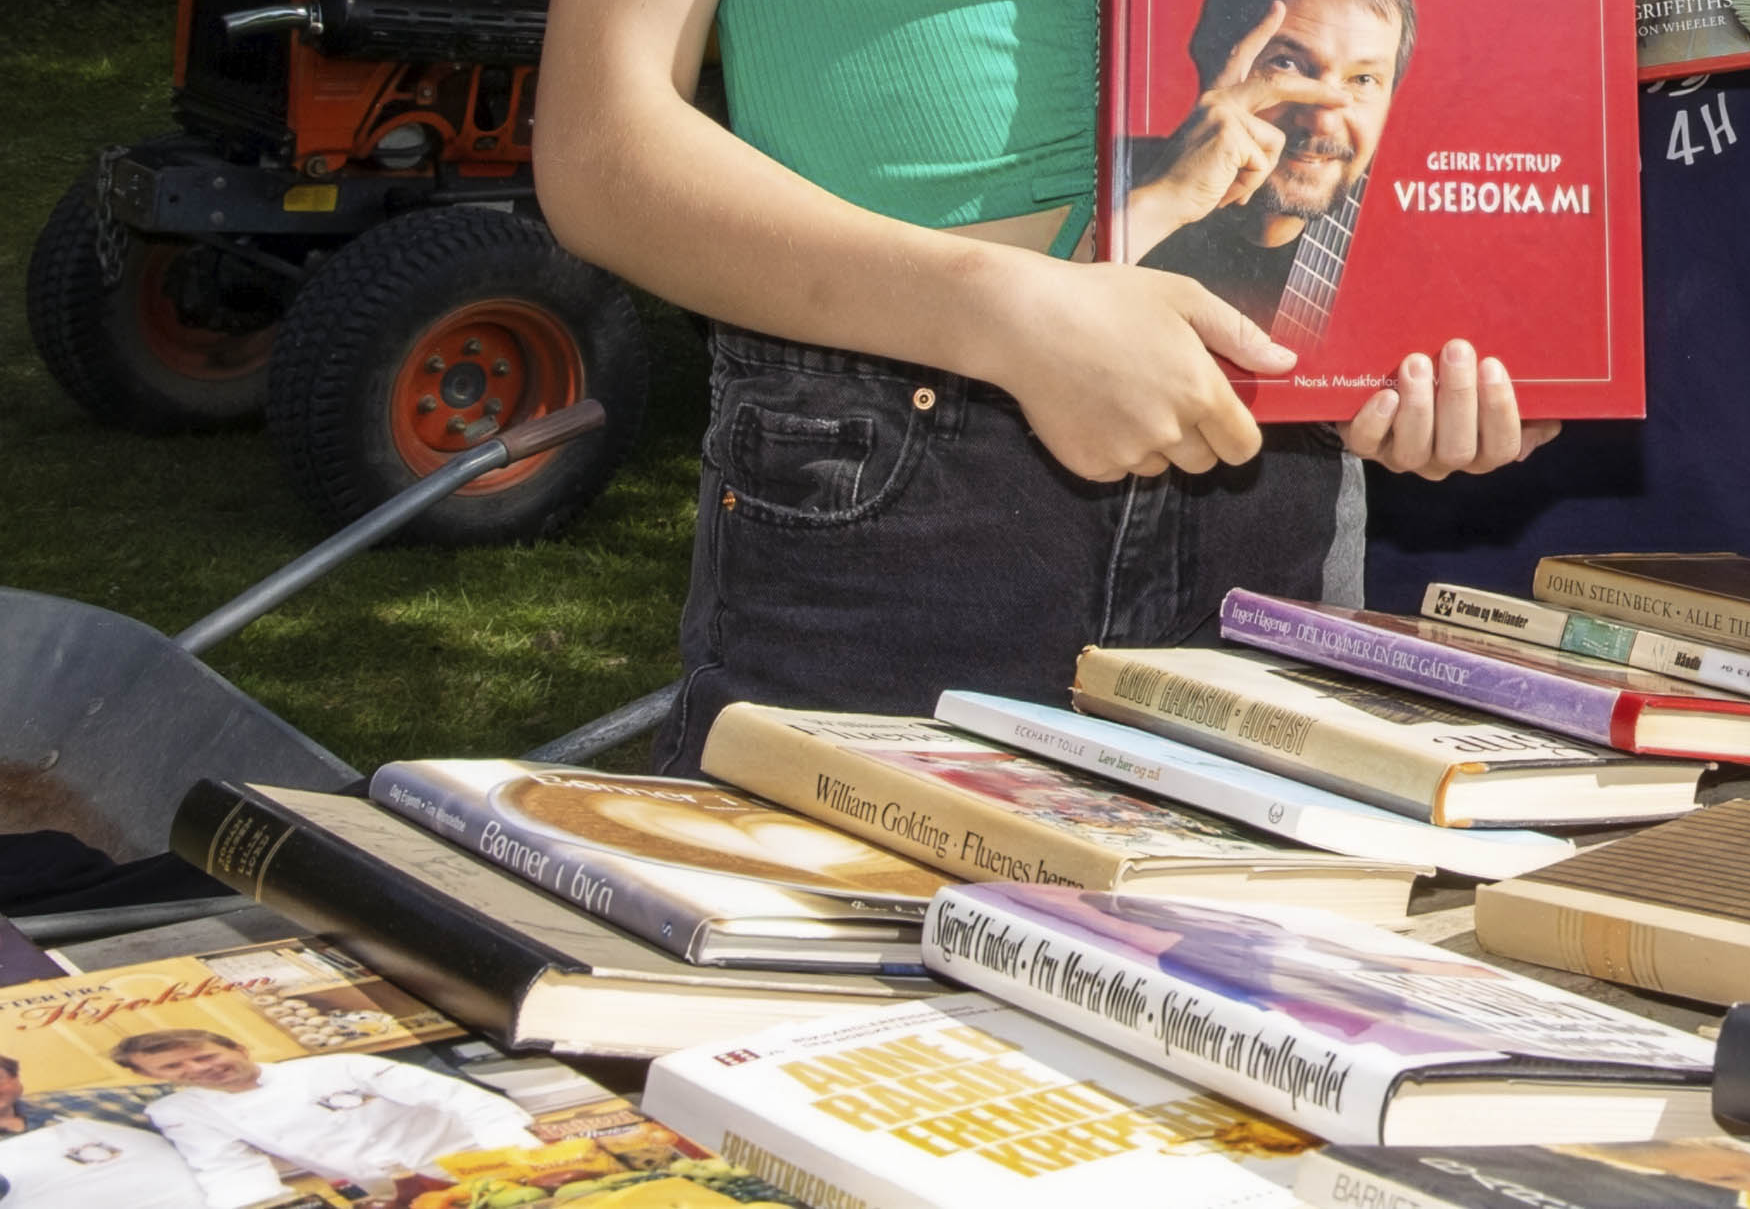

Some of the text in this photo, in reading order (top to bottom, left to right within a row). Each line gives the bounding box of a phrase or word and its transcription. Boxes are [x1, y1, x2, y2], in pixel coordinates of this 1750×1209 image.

[1663, 15, 1727, 34] WHEELER
[1666, 92, 1737, 165] 4H
[1427, 151, 1562, 173] GEIRR LYSTRUP
[1393, 181, 1590, 214] VISEBOKA MI
[1294, 374, 1328, 387] Norsk
[1546, 574, 1585, 596] JOHN
[1589, 583, 1672, 618] STEINBECK
[1684, 608, 1722, 632] ALLE
[1232, 603, 1470, 686] Inger Hagerup DET KOMMER EN PIKE GÅENDE
[1114, 661, 1320, 755] KNUT HAMSUN AUGUST
[1014, 725, 1161, 782] ECKHART TOLLE Lev her og nå
[480, 819, 549, 882] Bønner
[815, 773, 878, 824] William
[881, 801, 950, 859] Golding
[960, 829, 1031, 883] Fluenes
[933, 900, 1351, 1115] Sigrid Undset Fru Marta Oulie Splinten av trollspeilet
[777, 1033, 973, 1096] ANNE
